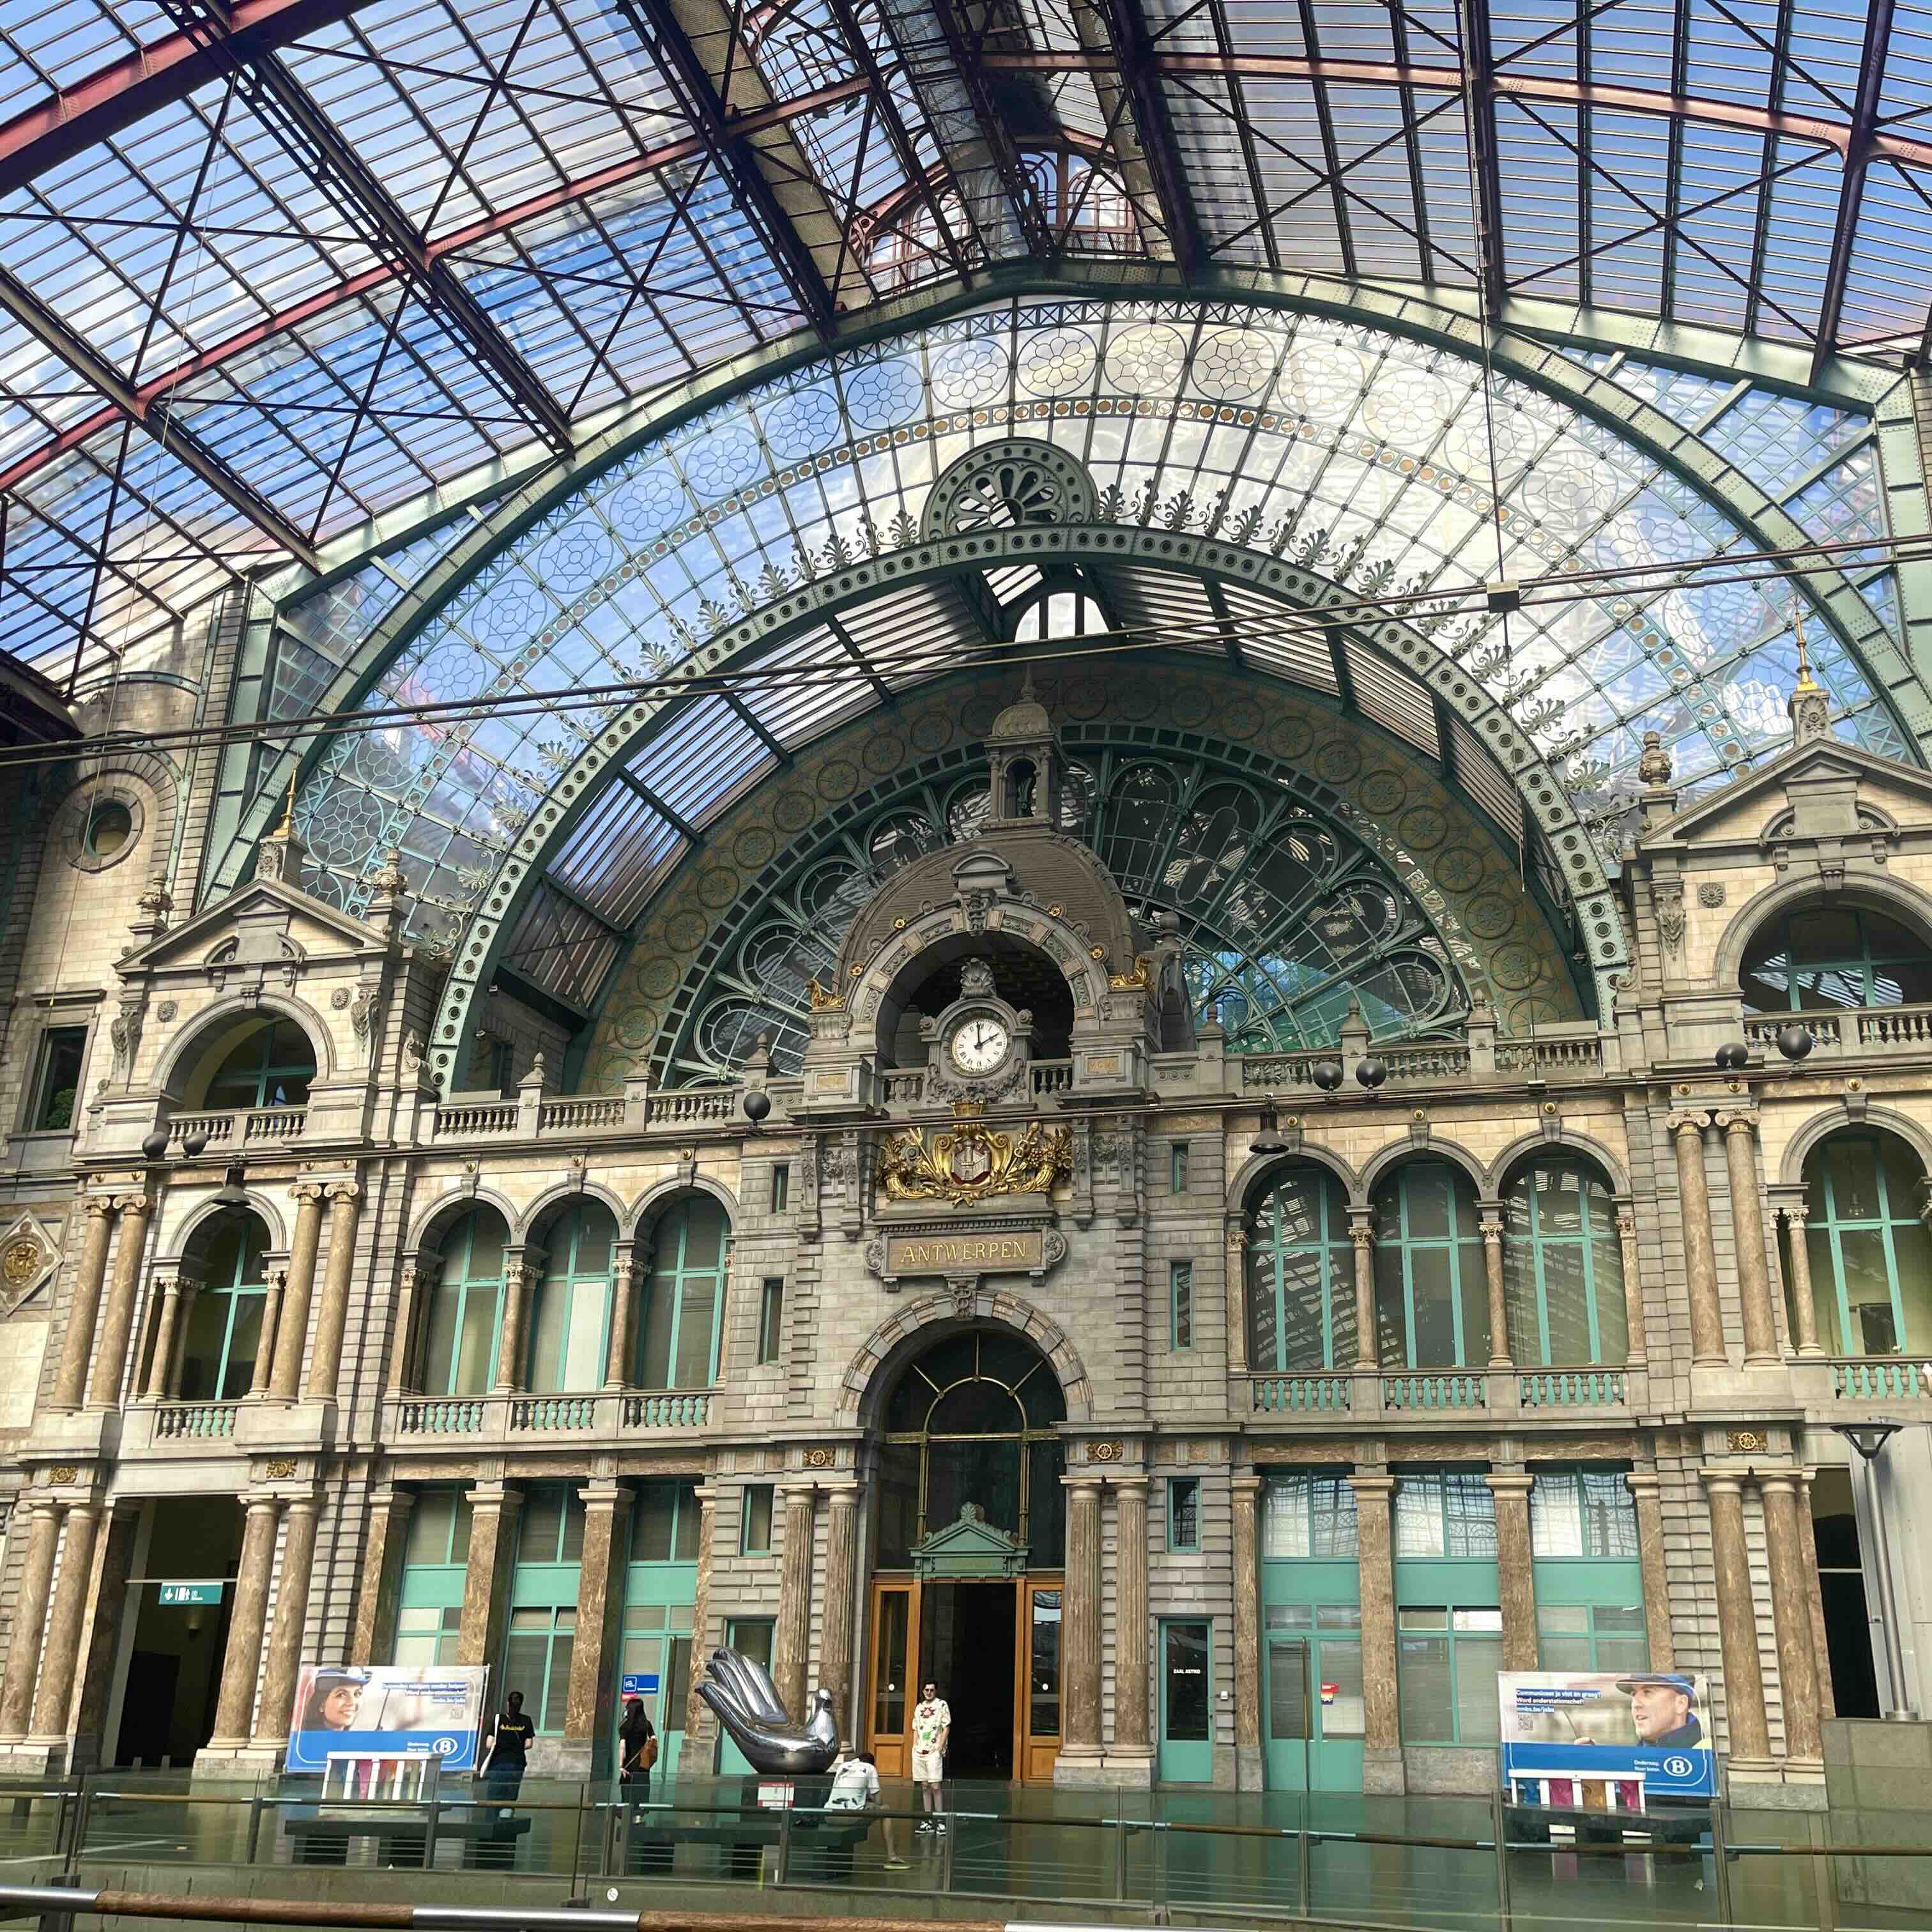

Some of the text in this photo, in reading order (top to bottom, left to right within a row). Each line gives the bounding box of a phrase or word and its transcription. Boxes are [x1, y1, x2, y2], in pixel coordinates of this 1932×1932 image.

[900, 1241, 1026, 1263] ANTWERPEN
[439, 1740, 452, 1753] B
[1671, 1759, 1685, 1774] B
